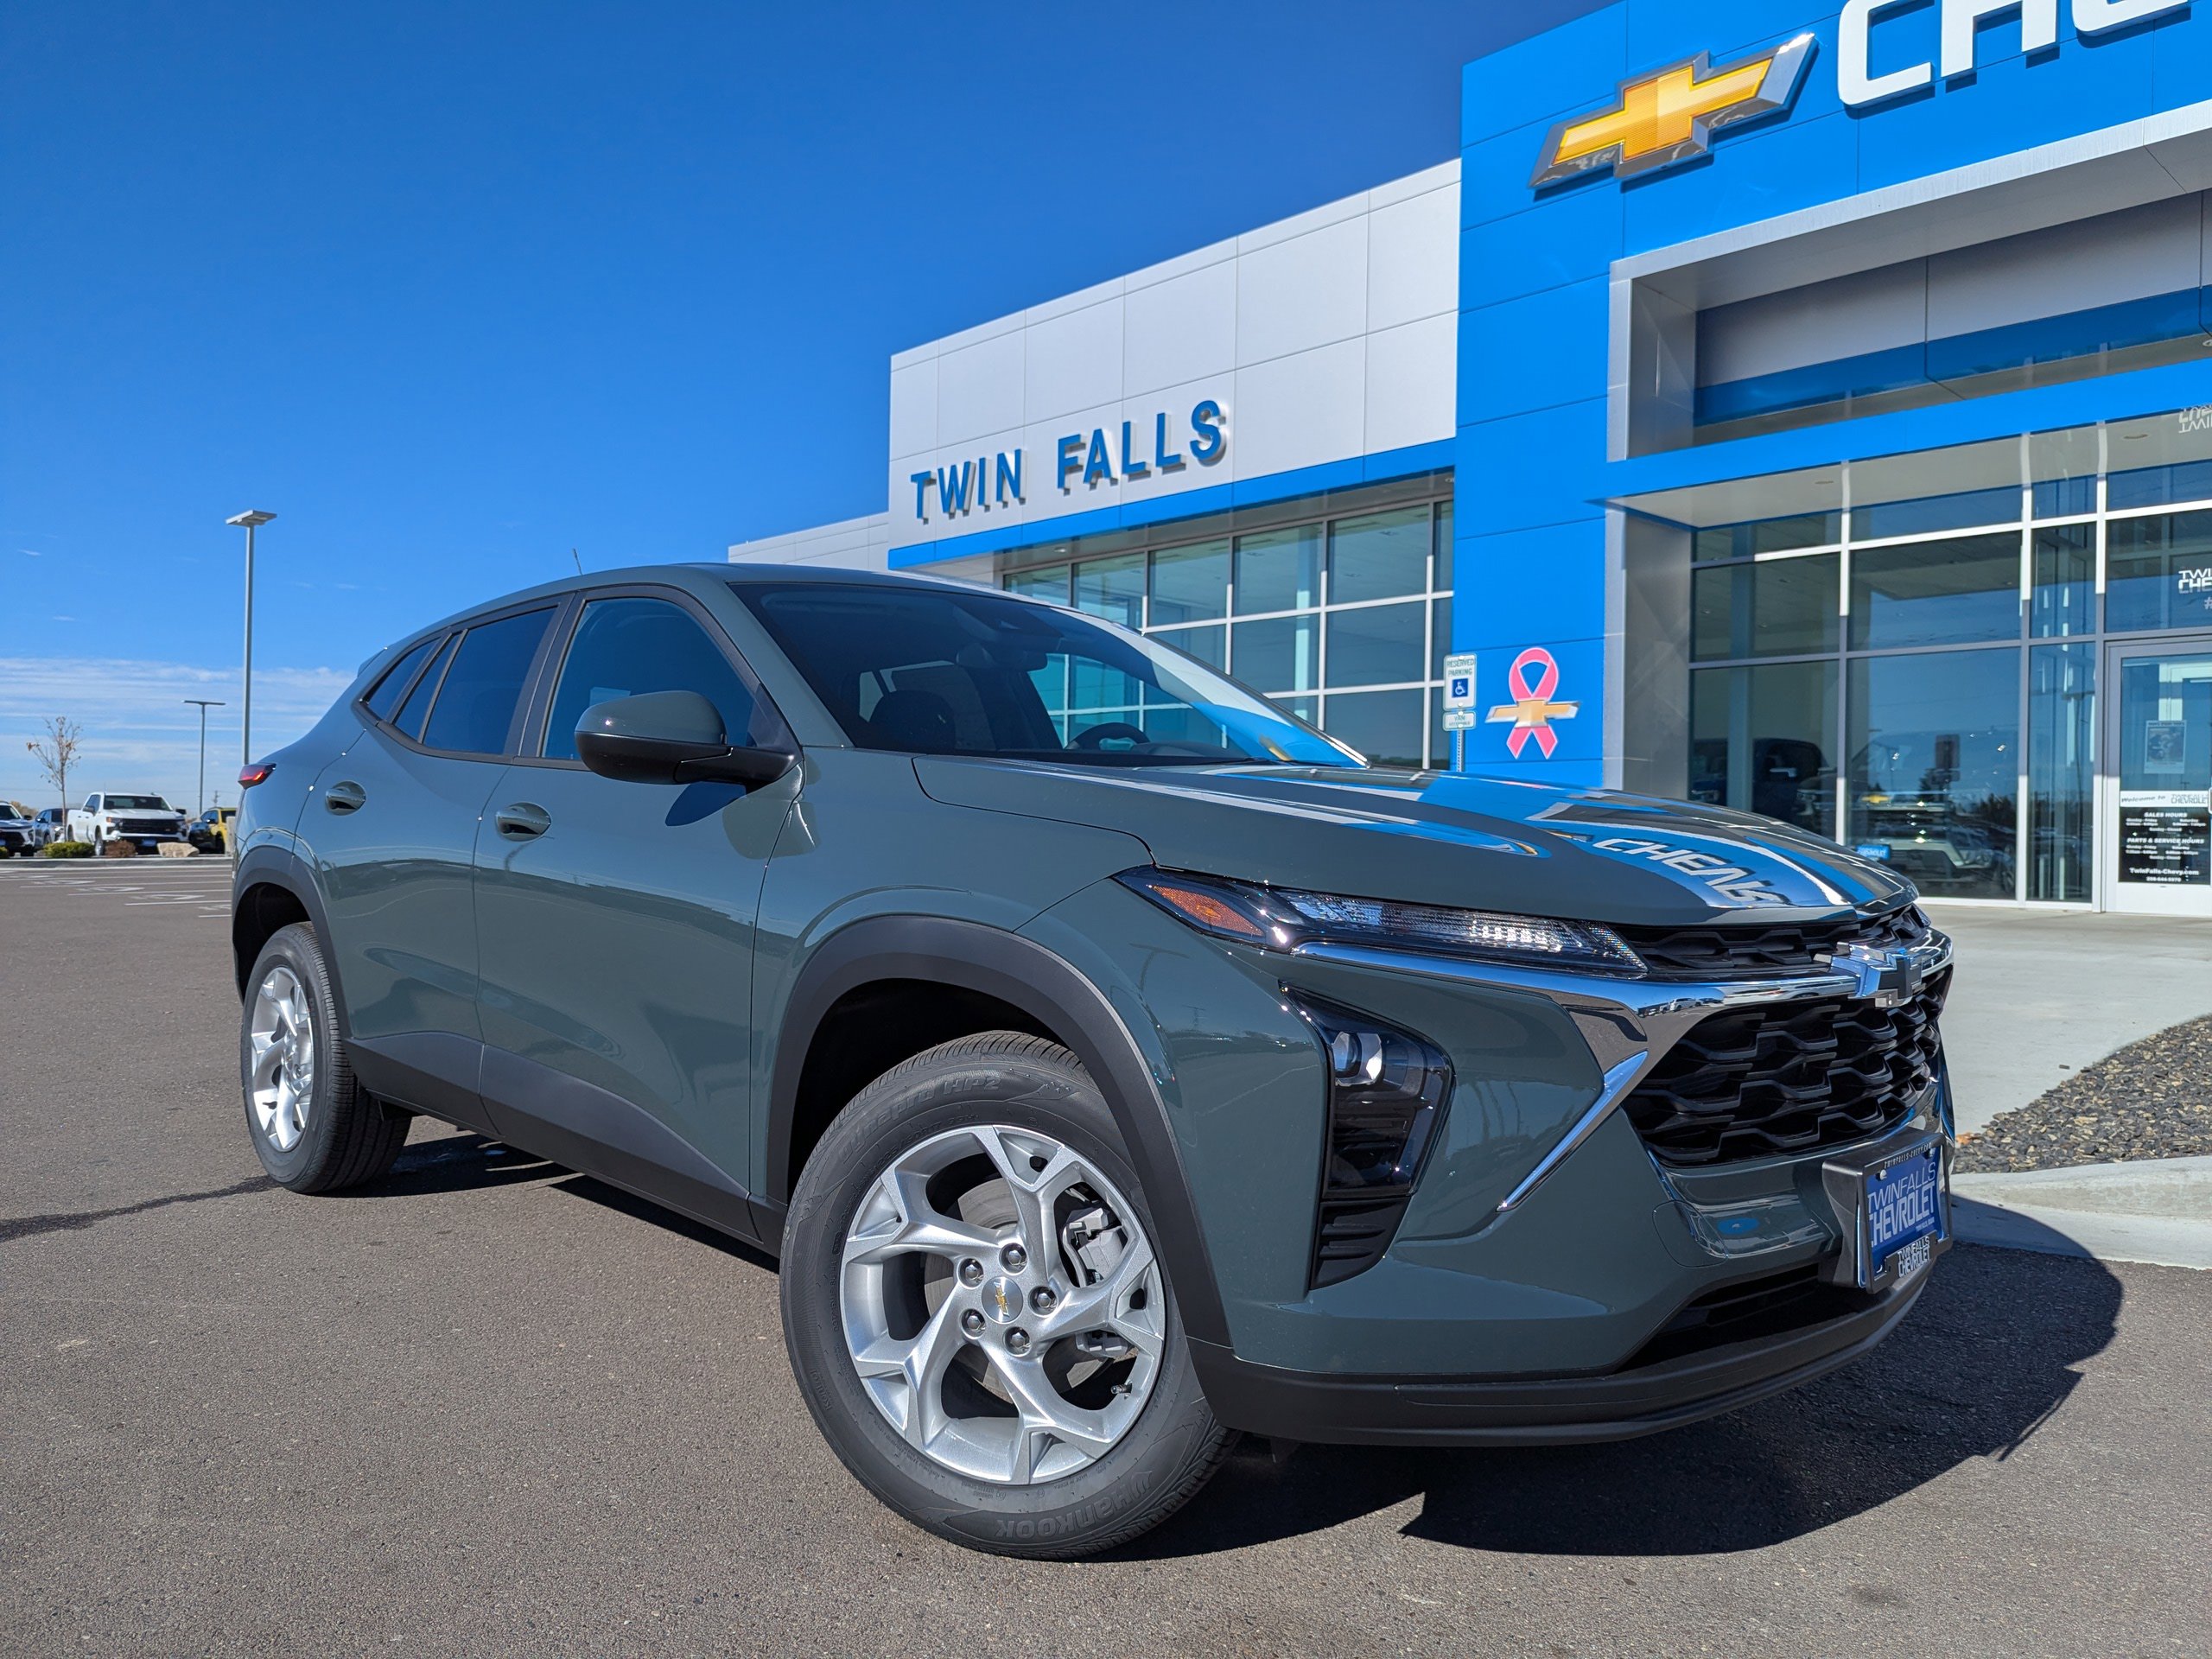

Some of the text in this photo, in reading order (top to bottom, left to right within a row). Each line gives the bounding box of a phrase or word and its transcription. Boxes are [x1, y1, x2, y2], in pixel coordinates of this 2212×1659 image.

[911, 399, 1227, 522] TWIN FALLS
[1447, 658, 1474, 668] RESERVED
[1448, 668, 1472, 677] PARKING
[1867, 1161, 1936, 1214] TWINFALLS
[1897, 1236, 1930, 1262] TWINFALLS
[1898, 1244, 1930, 1278] CHEVROLET
